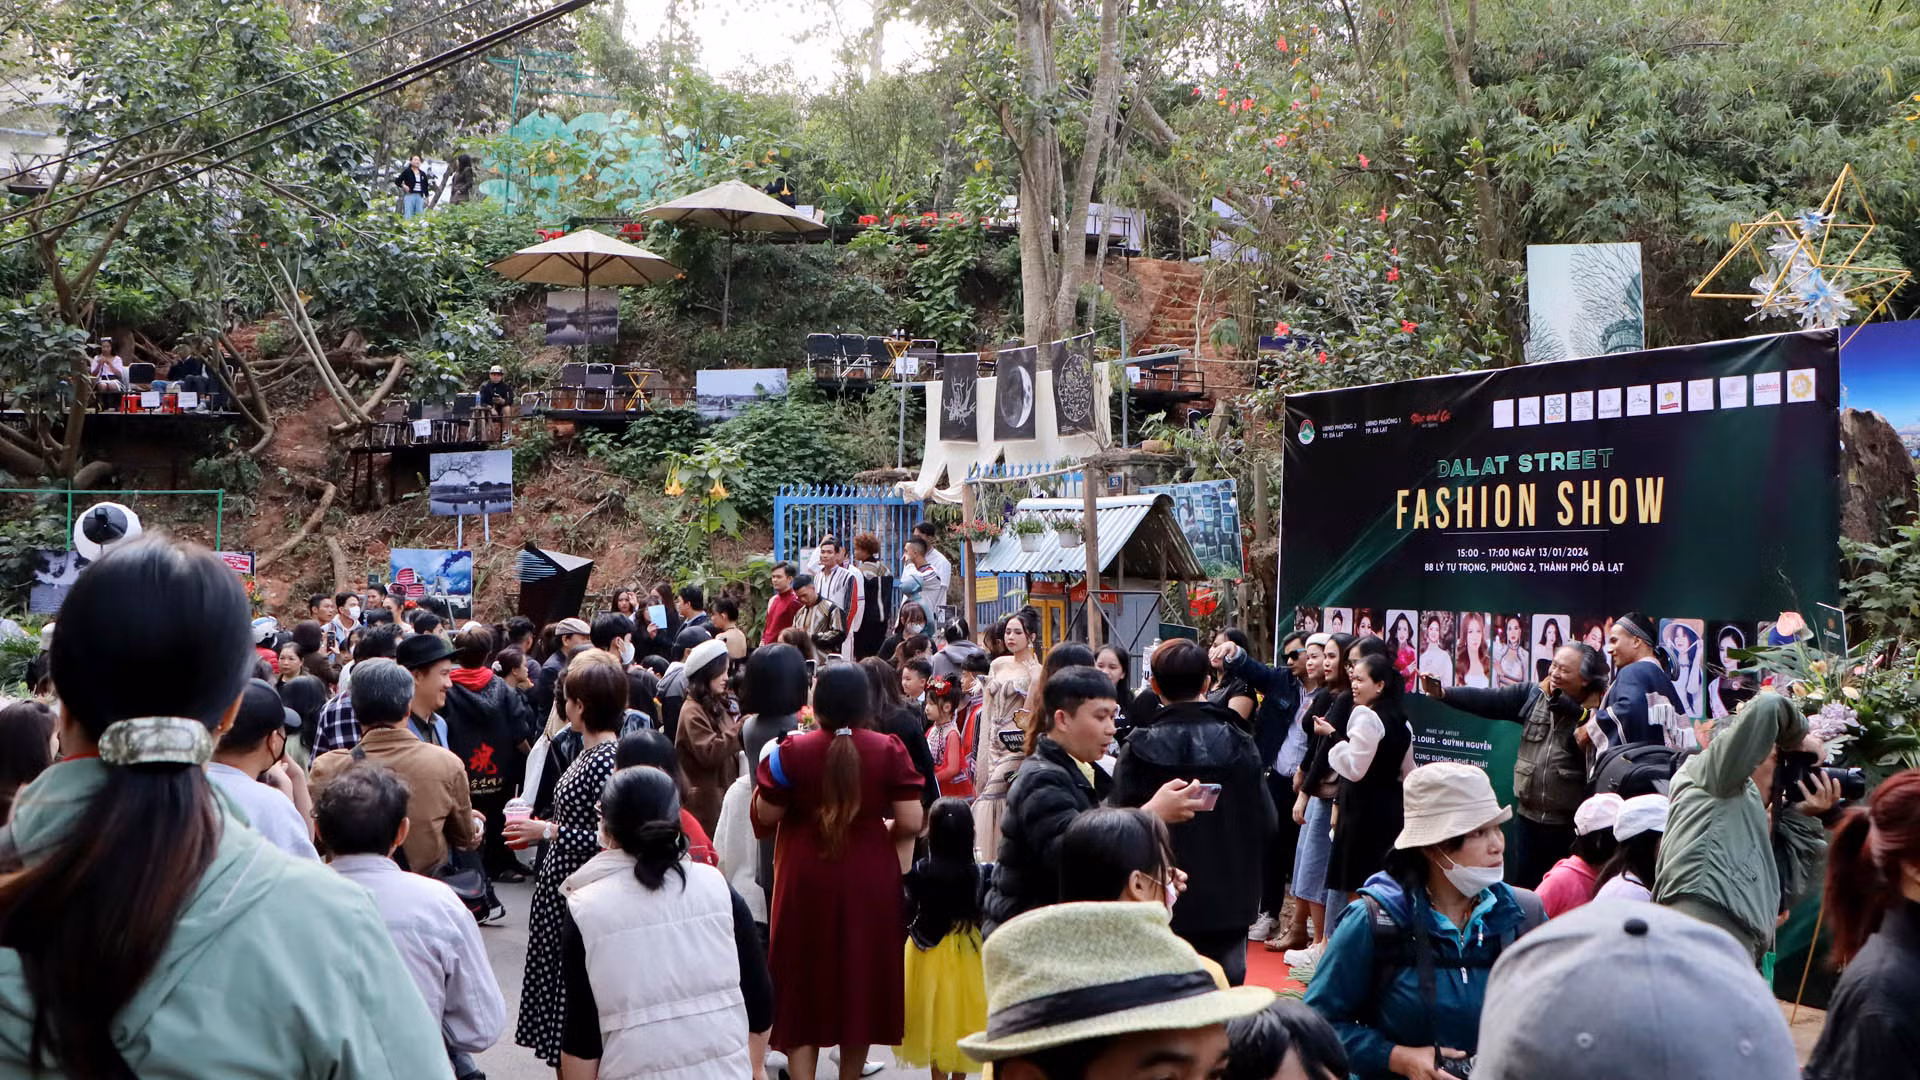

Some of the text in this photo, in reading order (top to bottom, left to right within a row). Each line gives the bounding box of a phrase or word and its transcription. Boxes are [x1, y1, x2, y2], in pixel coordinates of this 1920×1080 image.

[1437, 448, 1614, 478] DALAT STREET
[1396, 476, 1664, 530] FASHION SHOW
[1457, 548, 1479, 558] 15:00
[1488, 548, 1510, 558] 17:00
[1512, 546, 1536, 557] NGÀY
[1538, 547, 1589, 558] 13/01/2024
[1424, 560, 1624, 574] 88 LÝ TỰ TRỌNG, PHƯỜNG 2, THÀNH PHỐ ĐÀ LẠT
[1418, 736, 1435, 744] LOUIS
[1442, 737, 1464, 747] QUỲNH
[1466, 740, 1492, 751] NGUYỄN
